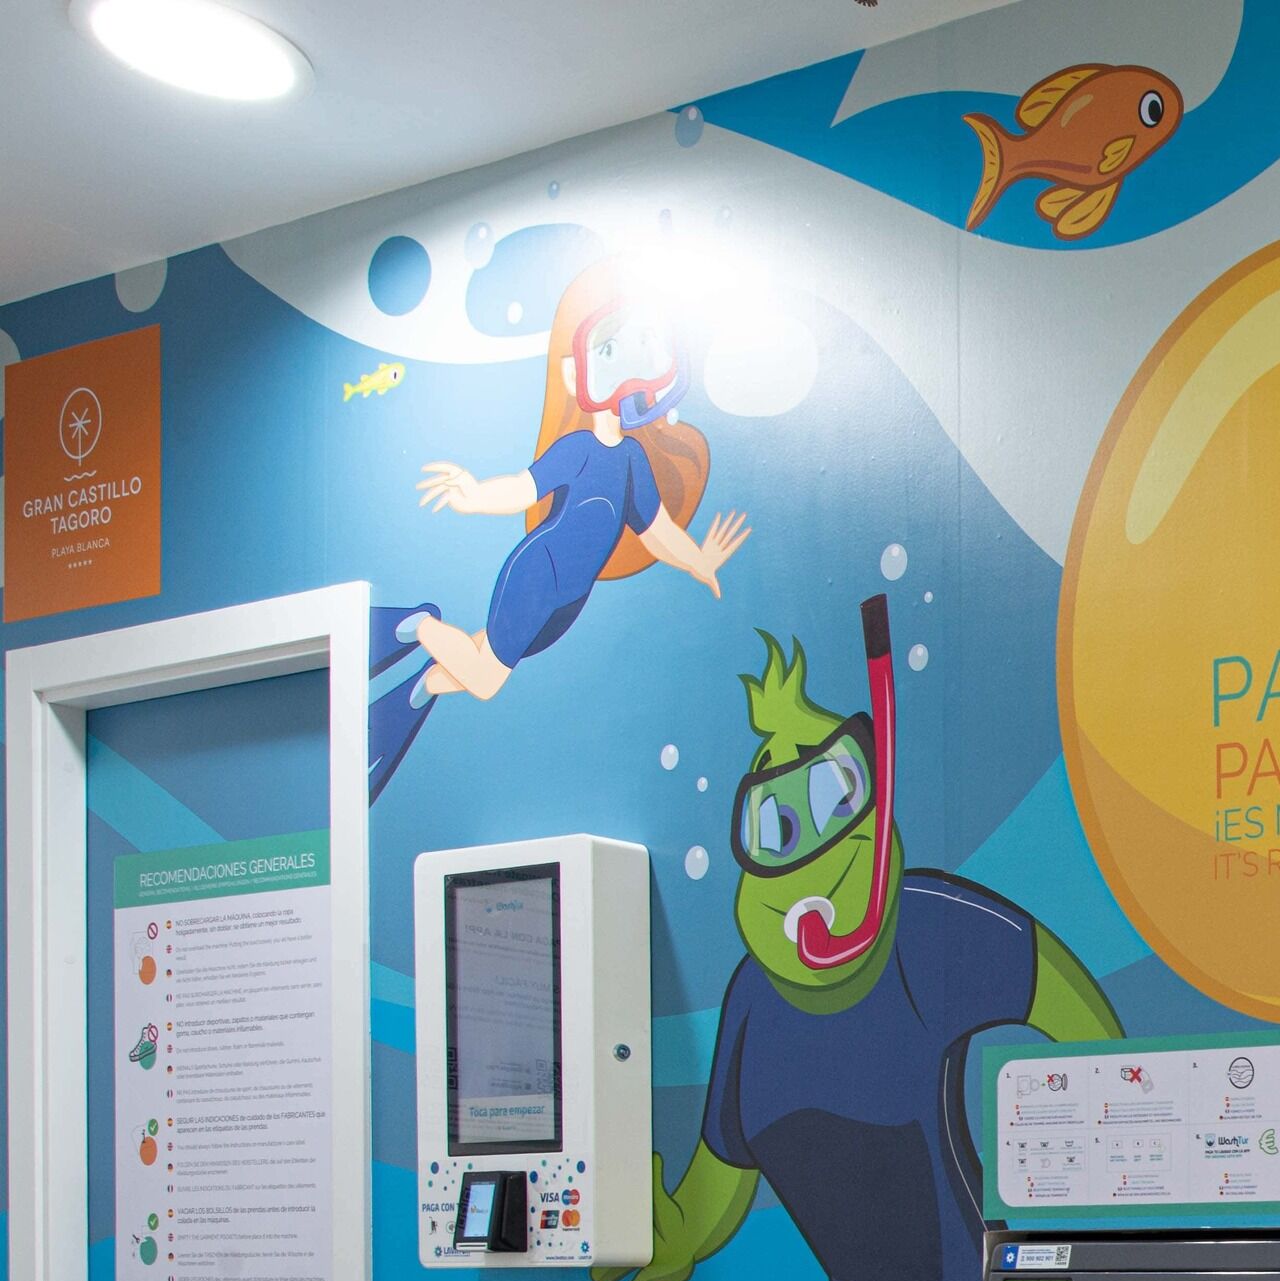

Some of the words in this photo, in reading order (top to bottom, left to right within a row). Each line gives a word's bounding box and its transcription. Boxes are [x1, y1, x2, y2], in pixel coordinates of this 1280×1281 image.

[23, 491, 64, 519] GRAN
[68, 476, 142, 508] CASTILLO
[50, 505, 112, 535] TAGORO
[51, 543, 76, 559] PLAYA
[76, 537, 110, 553] BLANCA
[1215, 805, 1264, 842] ¡ES
[139, 861, 247, 887] RECOMENDACIONES
[249, 853, 316, 874] GENERALES
[1213, 851, 1259, 881] IT'S
[469, 1107, 488, 1118] Toca
[489, 1107, 507, 1119] para
[509, 1105, 545, 1118] empezar
[422, 1203, 440, 1212] PAGA
[441, 1203, 455, 1211] CON
[540, 1193, 560, 1203] VISA
